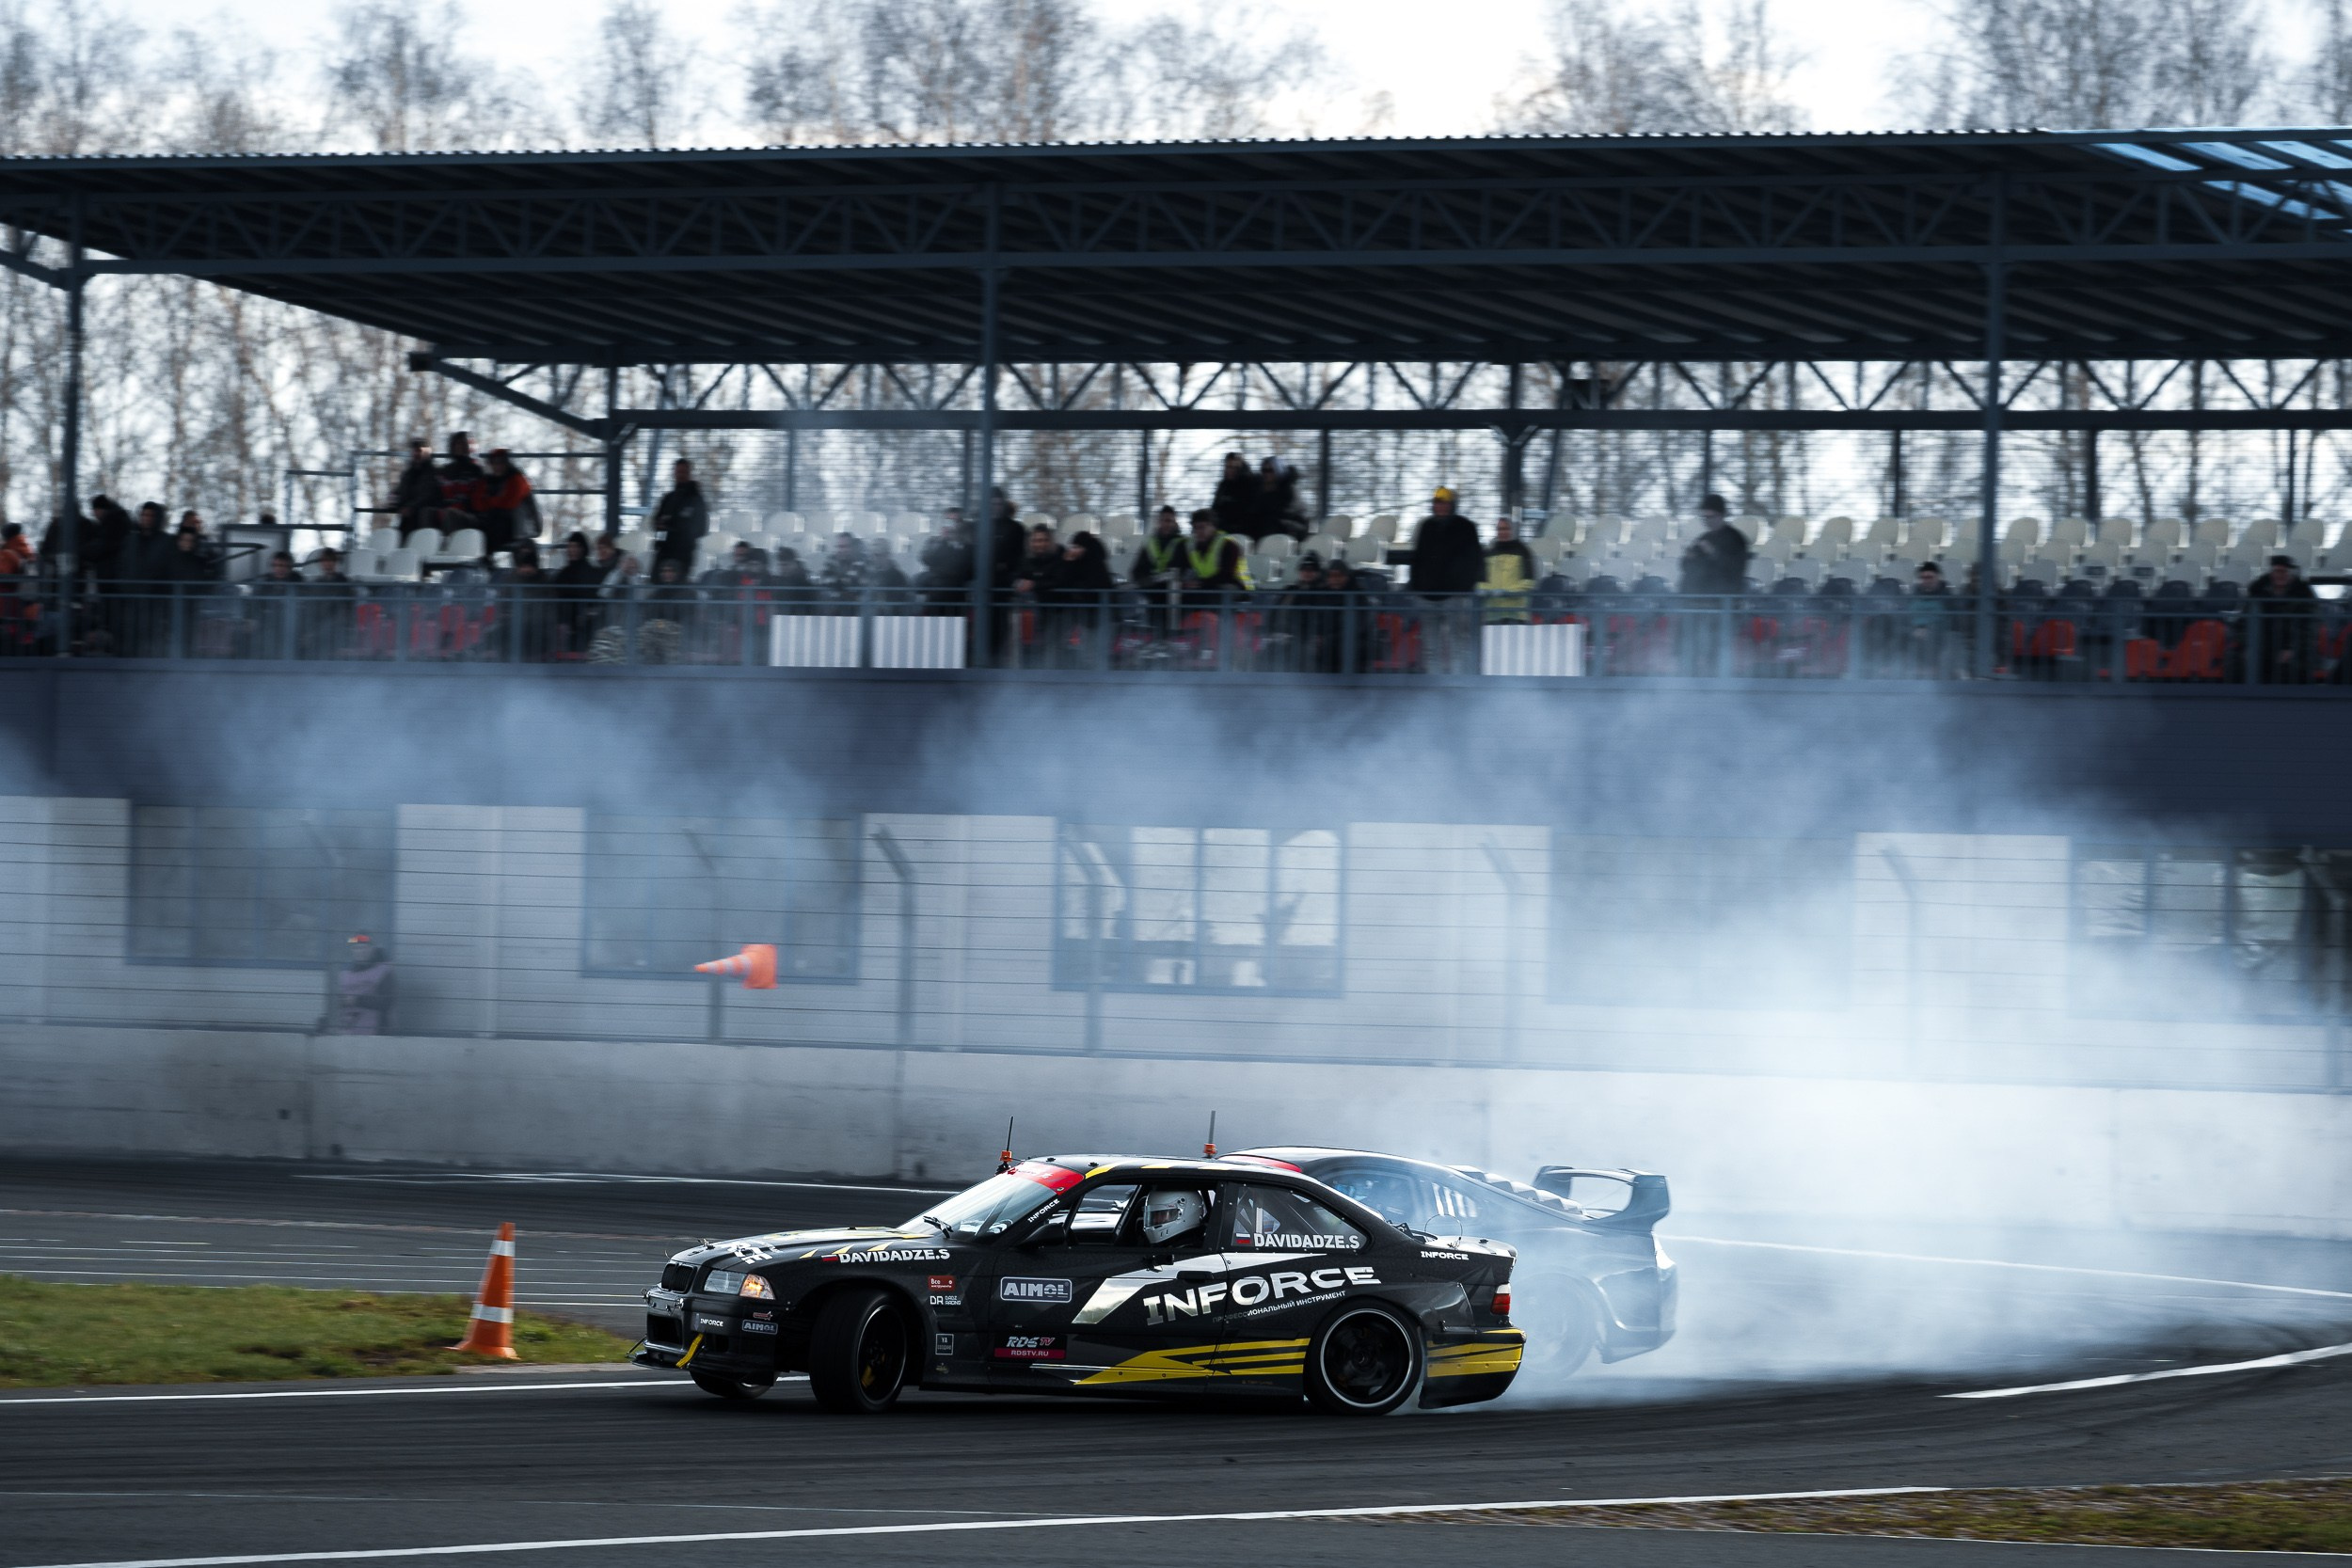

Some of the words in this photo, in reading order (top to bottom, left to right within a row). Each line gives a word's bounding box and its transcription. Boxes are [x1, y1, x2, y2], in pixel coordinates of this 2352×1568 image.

[1026, 1198, 1060, 1223] INFORCE
[1254, 1233, 1360, 1249] DAVIDADZE.S
[838, 1249, 950, 1263] DAVIDADZE.S
[1421, 1251, 1469, 1260] INFORCE
[1003, 1282, 1069, 1298] AIMOL
[1143, 1266, 1382, 1326] INFORCE
[930, 1295, 944, 1306] DR
[1296, 1290, 1346, 1307] ИНСТРУМЕНТ
[700, 1318, 723, 1327] INFORCE
[743, 1322, 776, 1332] AIMOL
[1006, 1336, 1040, 1348] RDS
